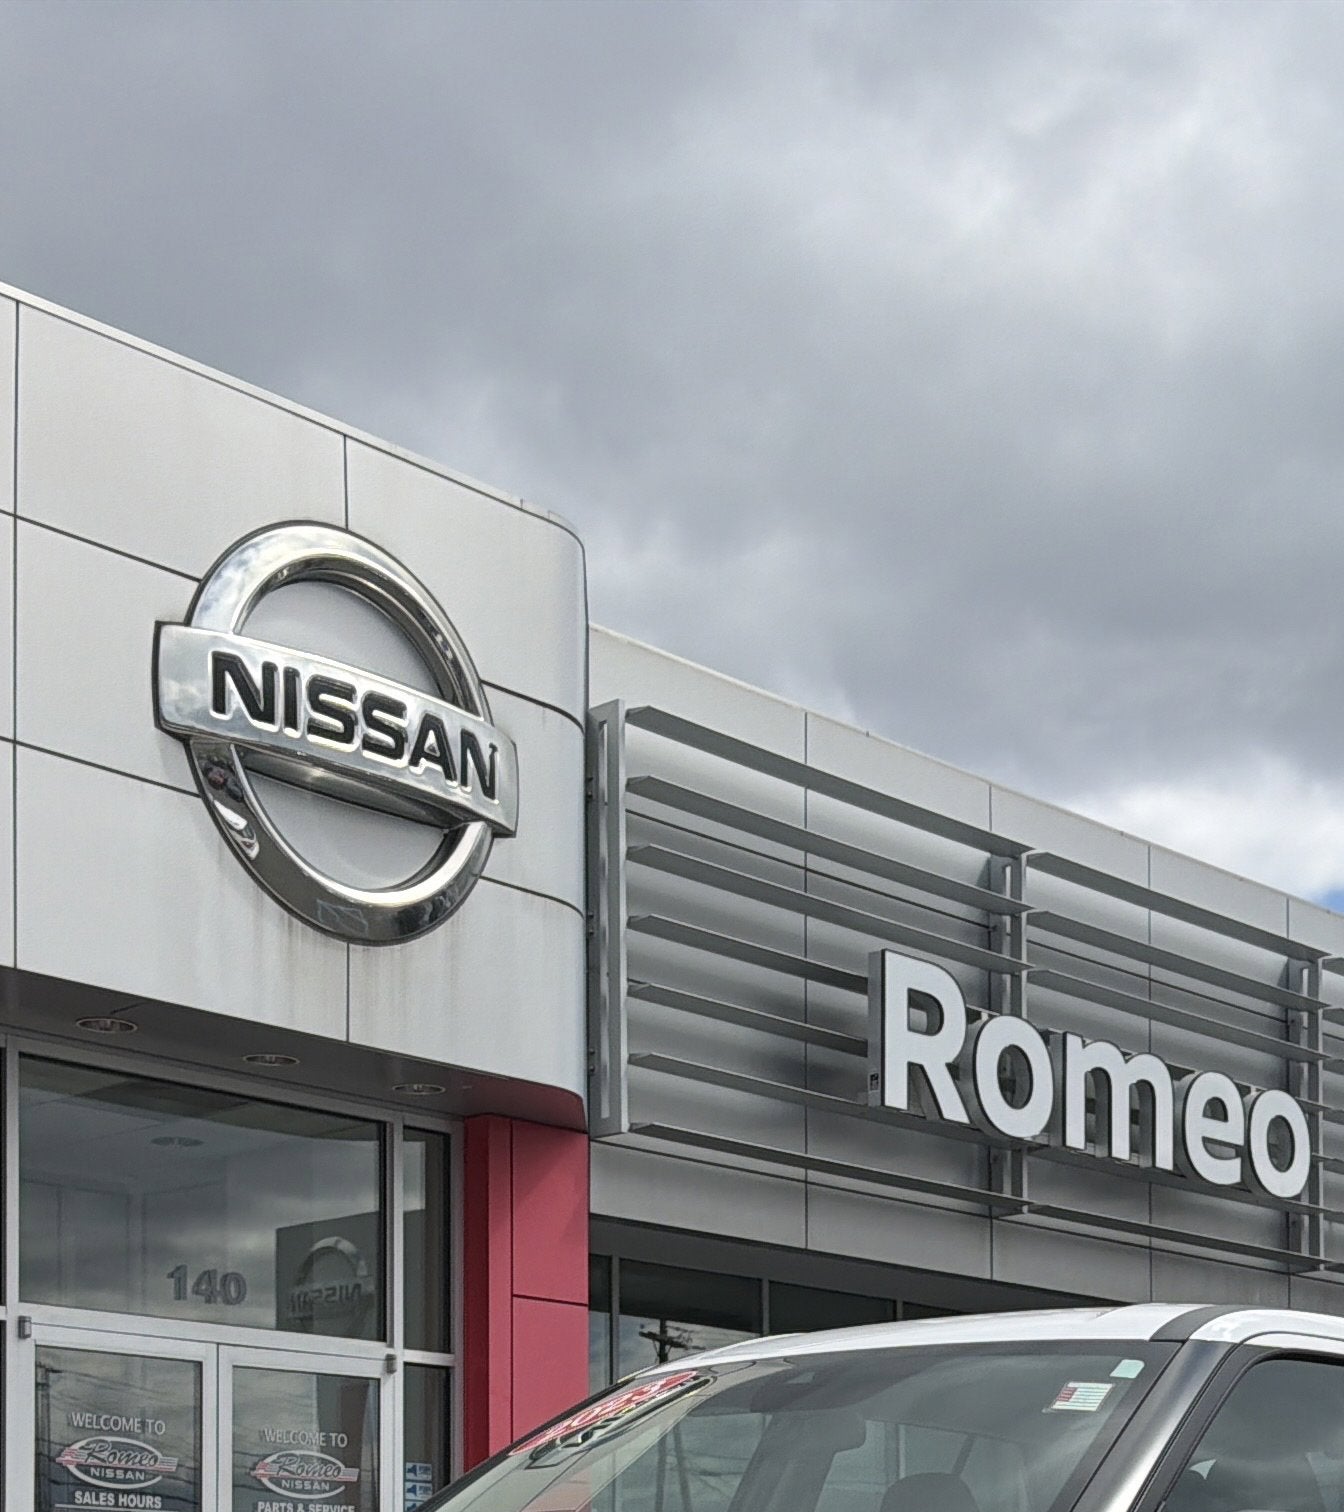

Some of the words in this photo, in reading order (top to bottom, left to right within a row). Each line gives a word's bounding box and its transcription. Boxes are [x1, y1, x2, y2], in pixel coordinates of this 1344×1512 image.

[210, 650, 499, 804] NISSAN
[870, 948, 1312, 1199] Romeo
[166, 1264, 247, 1306] 140
[71, 1411, 141, 1433] WELCOME
[146, 1419, 166, 1436] TO
[264, 1427, 327, 1447] WELCOME
[330, 1432, 348, 1449] TO
[79, 1439, 159, 1466] Romeo
[271, 1452, 342, 1478] Romeo
[90, 1466, 145, 1481] NISSAN
[281, 1479, 330, 1491] NISSAN
[75, 1490, 115, 1506] SALES
[118, 1493, 162, 1509] HOURS
